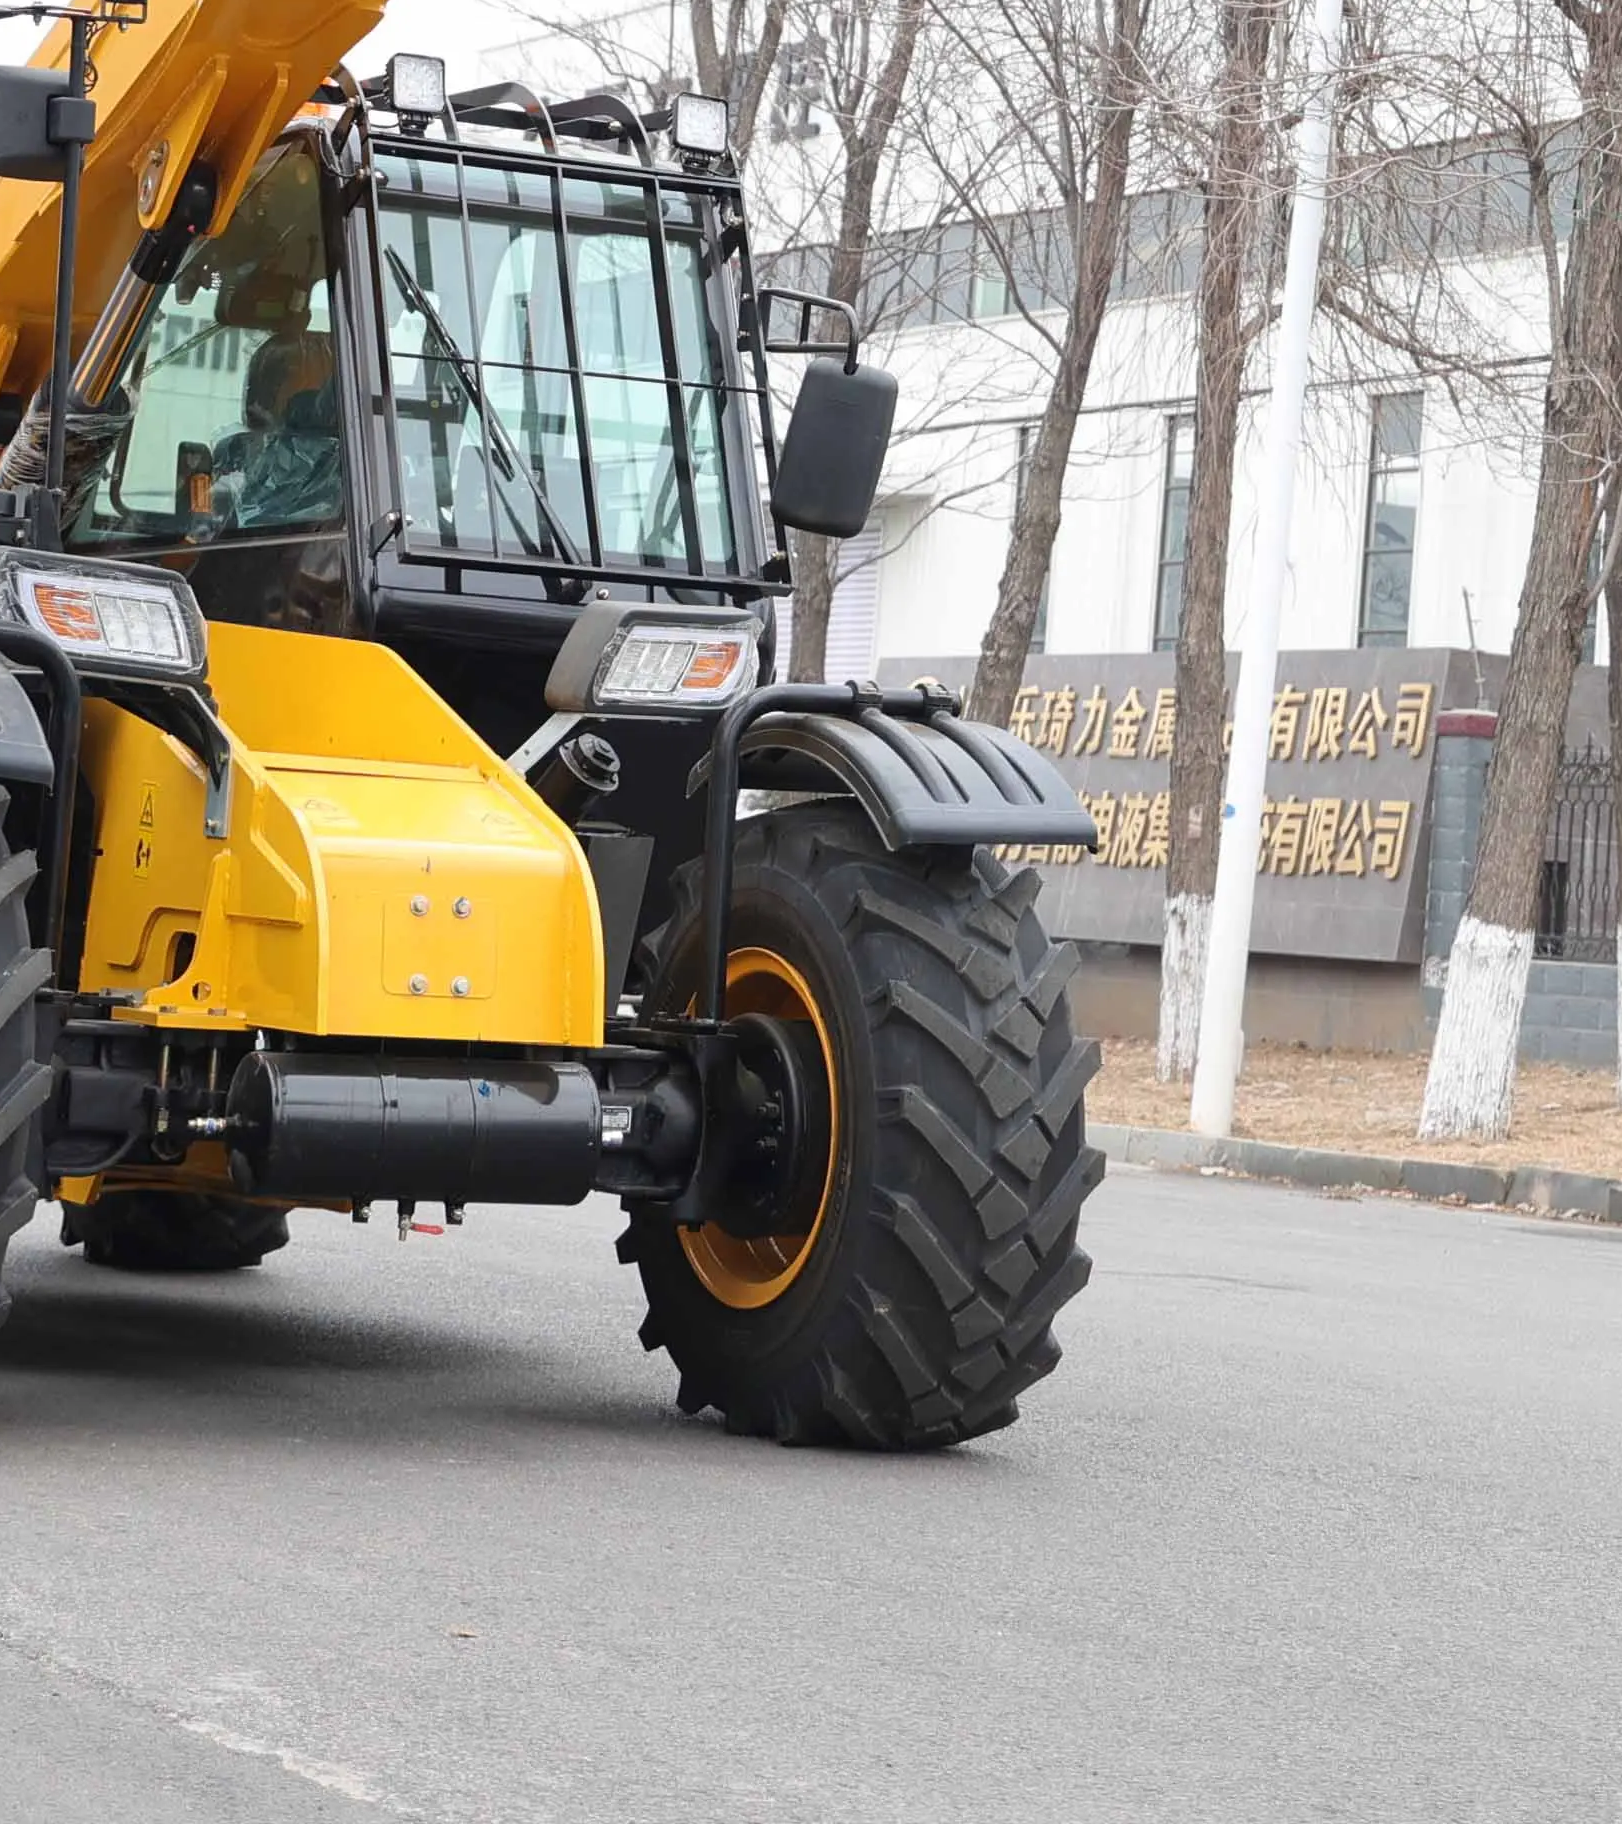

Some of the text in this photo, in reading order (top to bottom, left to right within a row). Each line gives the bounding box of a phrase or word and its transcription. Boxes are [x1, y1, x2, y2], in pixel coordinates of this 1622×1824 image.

[1010, 682, 1434, 761] 乐琦力金属有限公司
